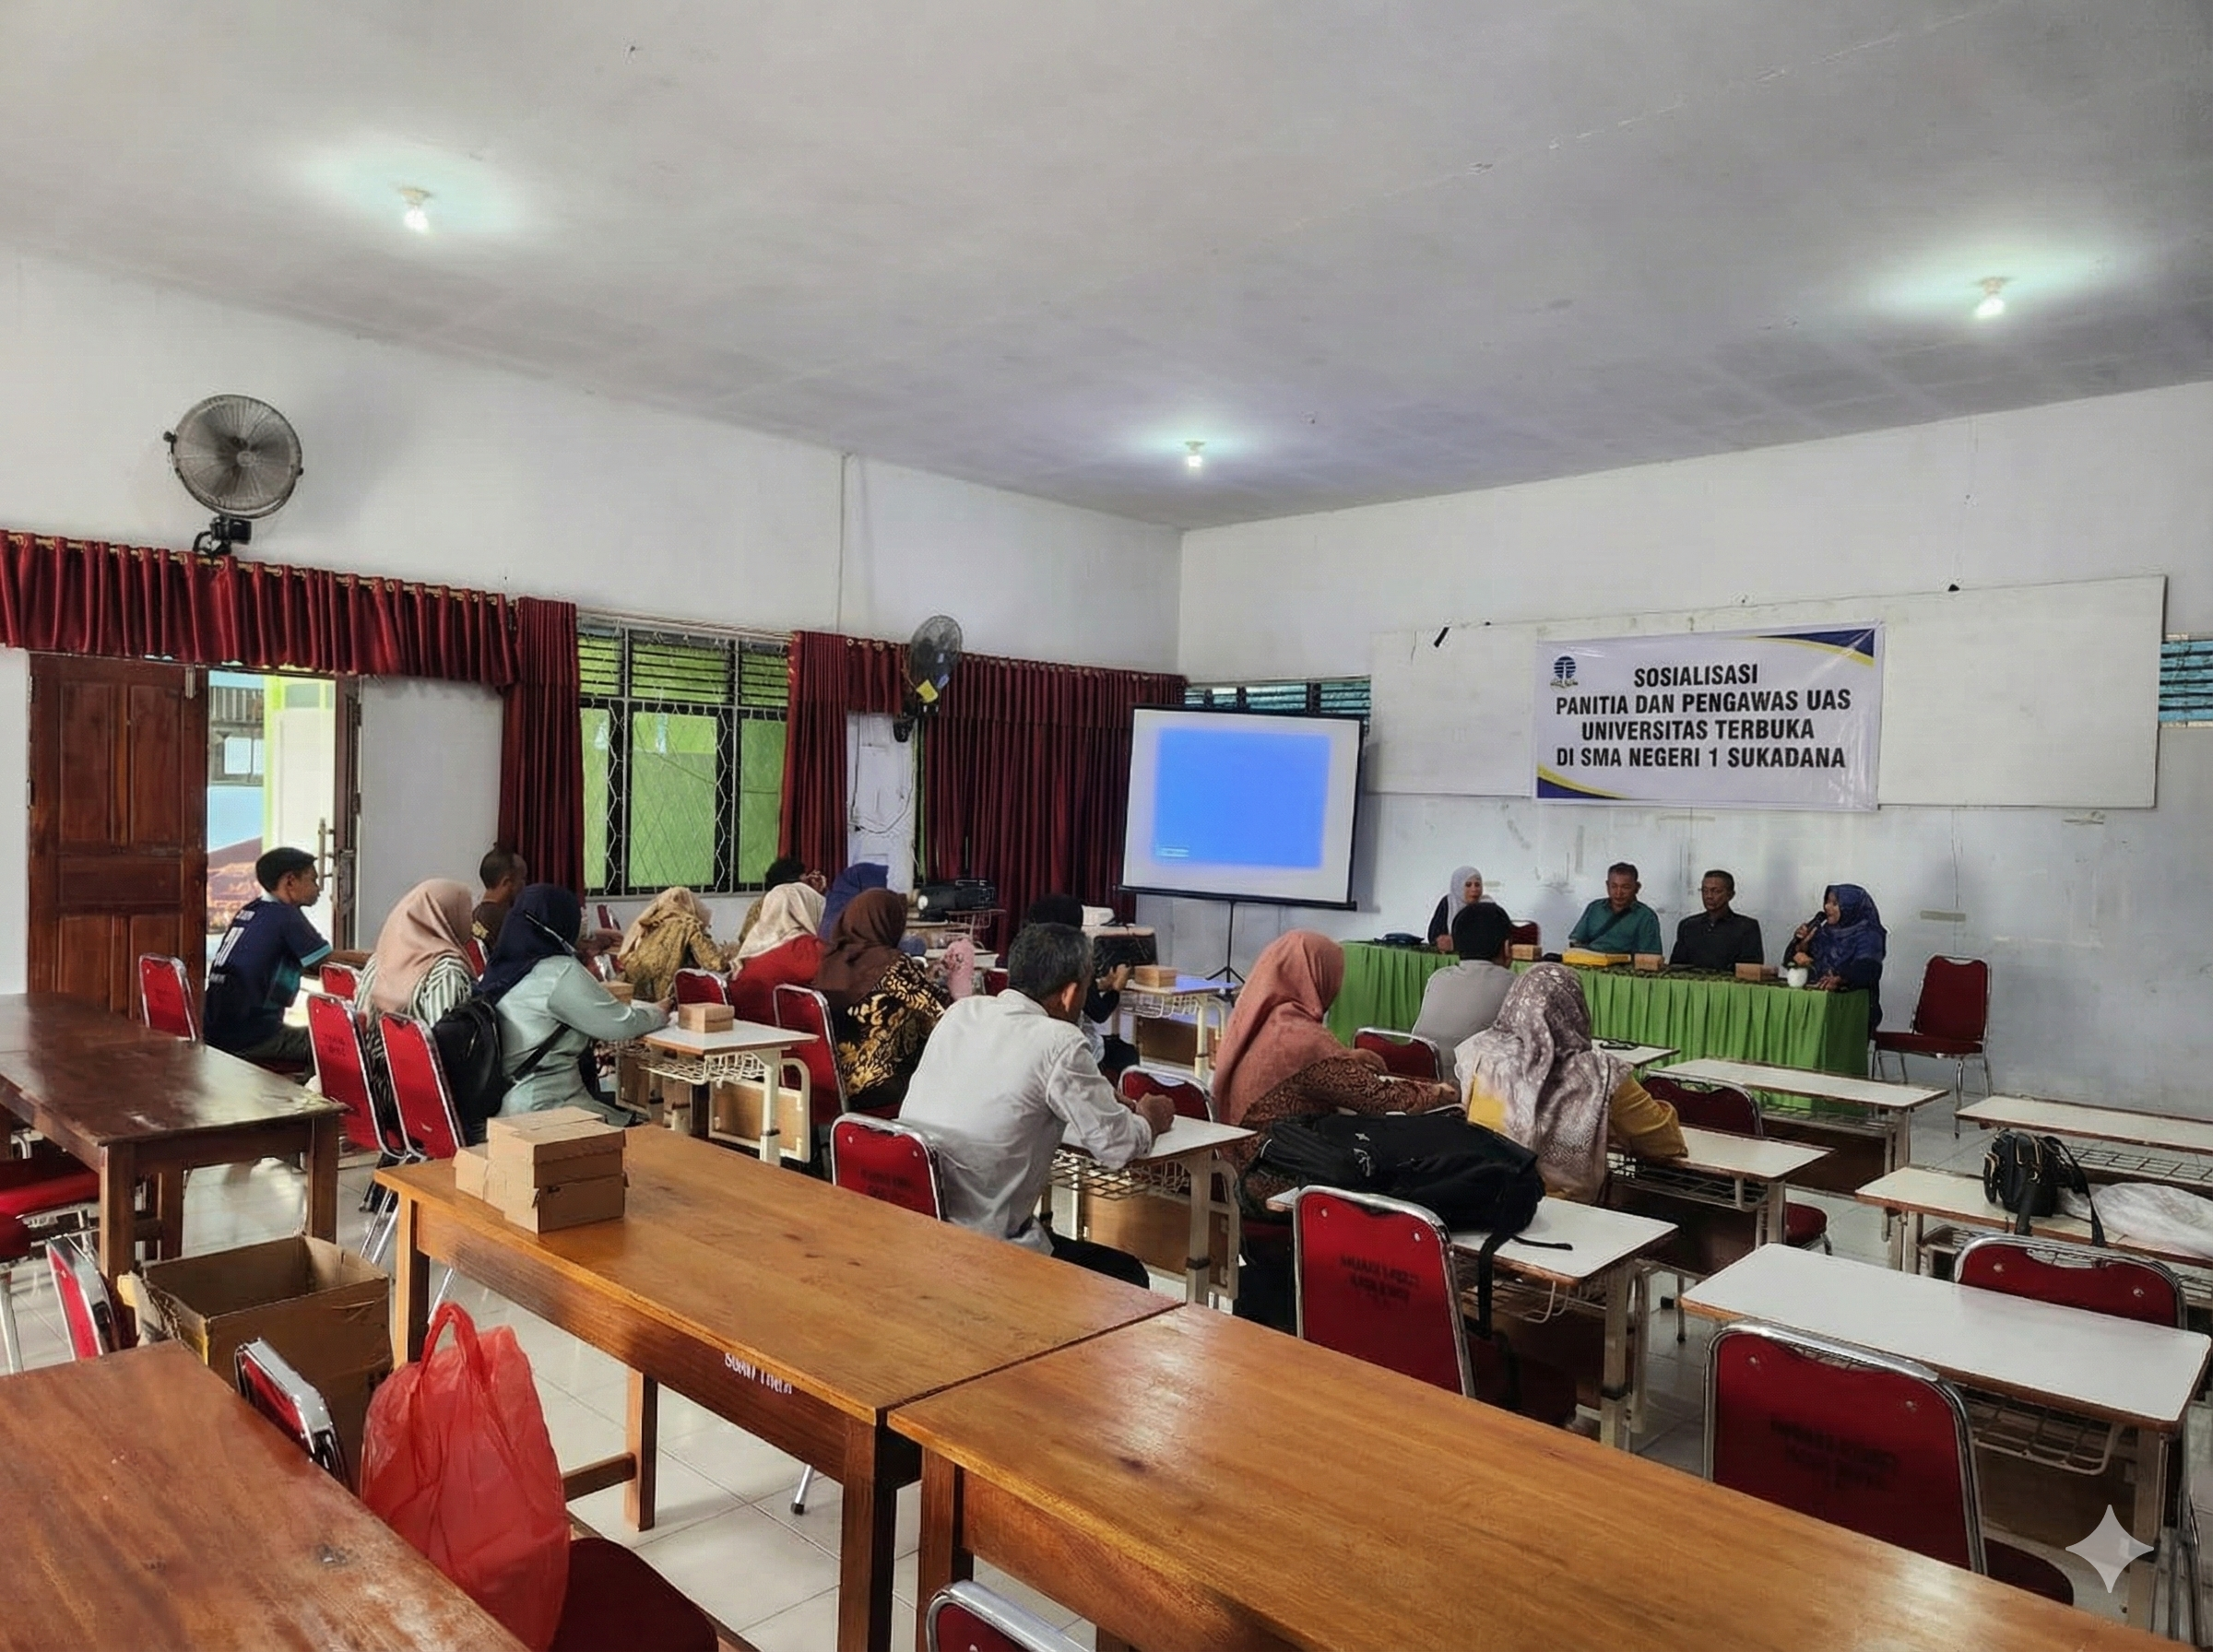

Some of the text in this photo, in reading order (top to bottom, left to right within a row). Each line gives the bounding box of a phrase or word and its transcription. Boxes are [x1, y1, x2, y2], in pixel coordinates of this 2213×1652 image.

[1633, 663, 1758, 689] SOSIALISASI
[1556, 688, 1852, 715] PANITIA DAN PENGAWAS UAS
[1581, 718, 1815, 741] UNIVERSITAS TERBUKA
[1556, 747, 1846, 769] DI SMA NEGERI 1 SUKADANA
